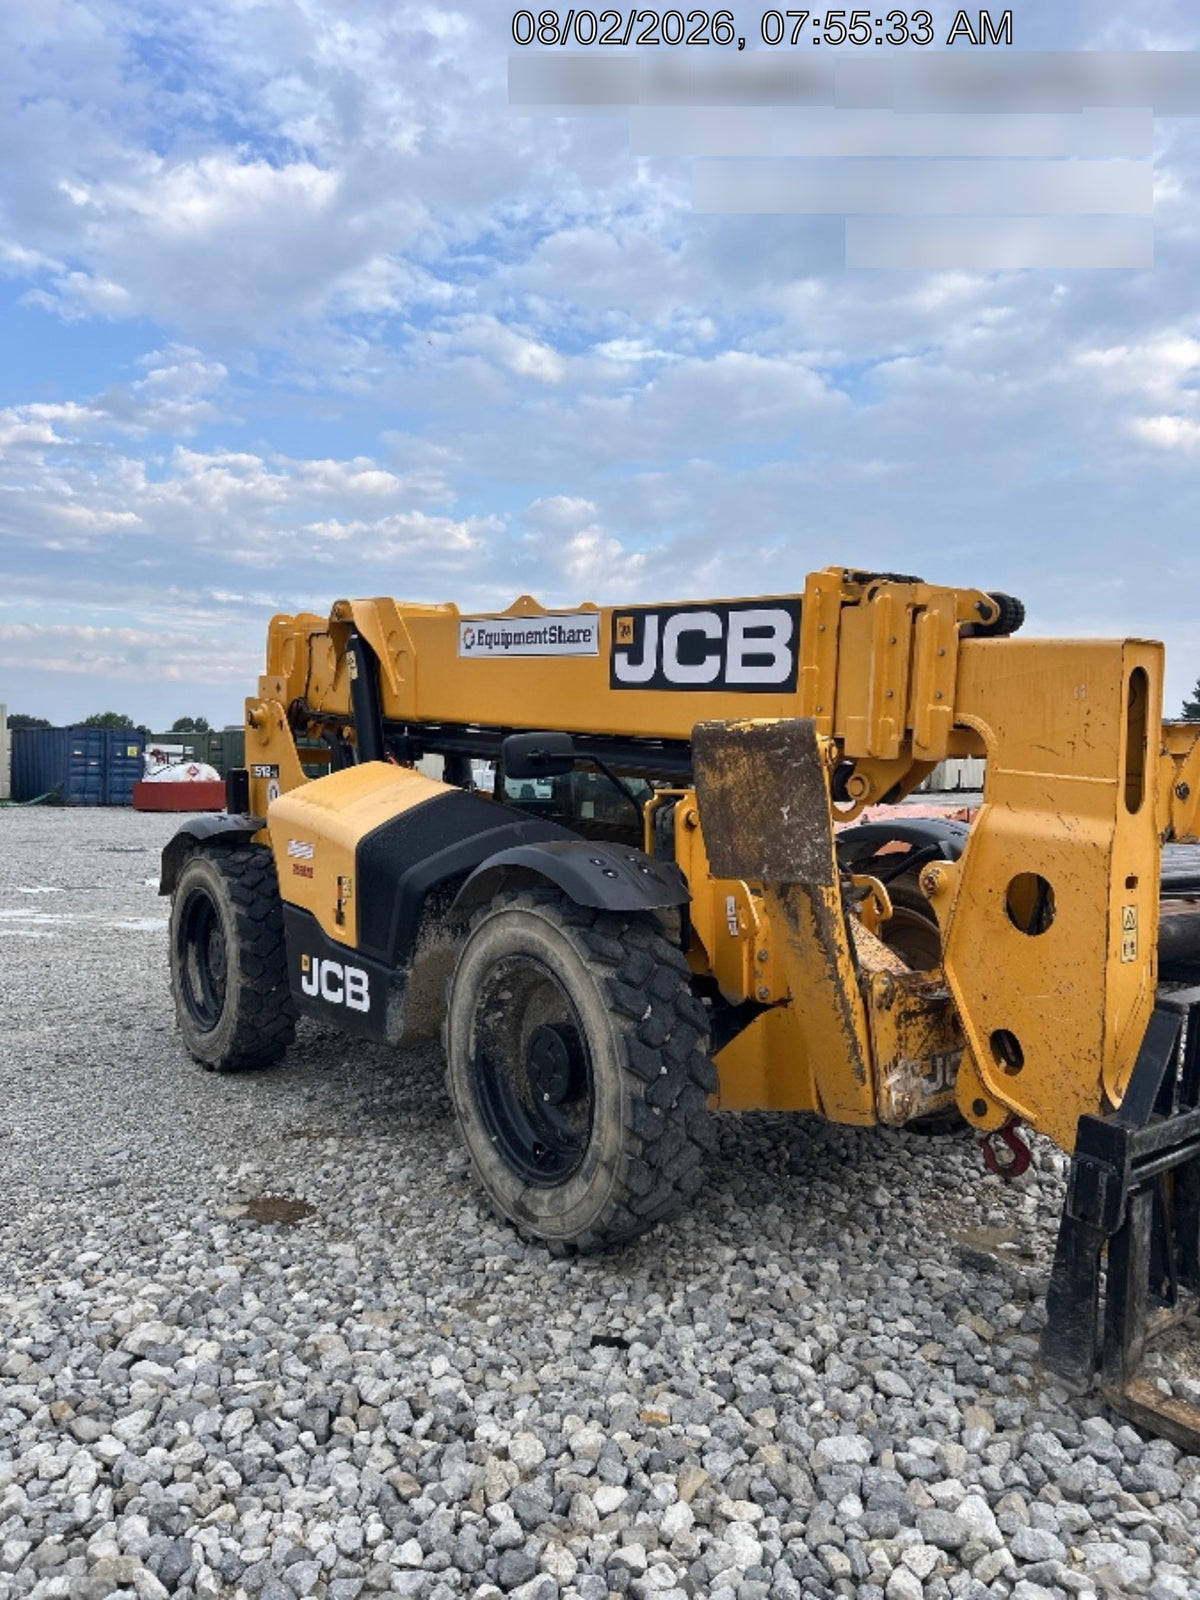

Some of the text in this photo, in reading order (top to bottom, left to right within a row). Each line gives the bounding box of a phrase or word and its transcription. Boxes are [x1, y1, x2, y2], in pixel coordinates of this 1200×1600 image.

[476, 625, 592, 649] EquipmentShare
[614, 609, 793, 684] JCB
[301, 956, 370, 1012] JCB
